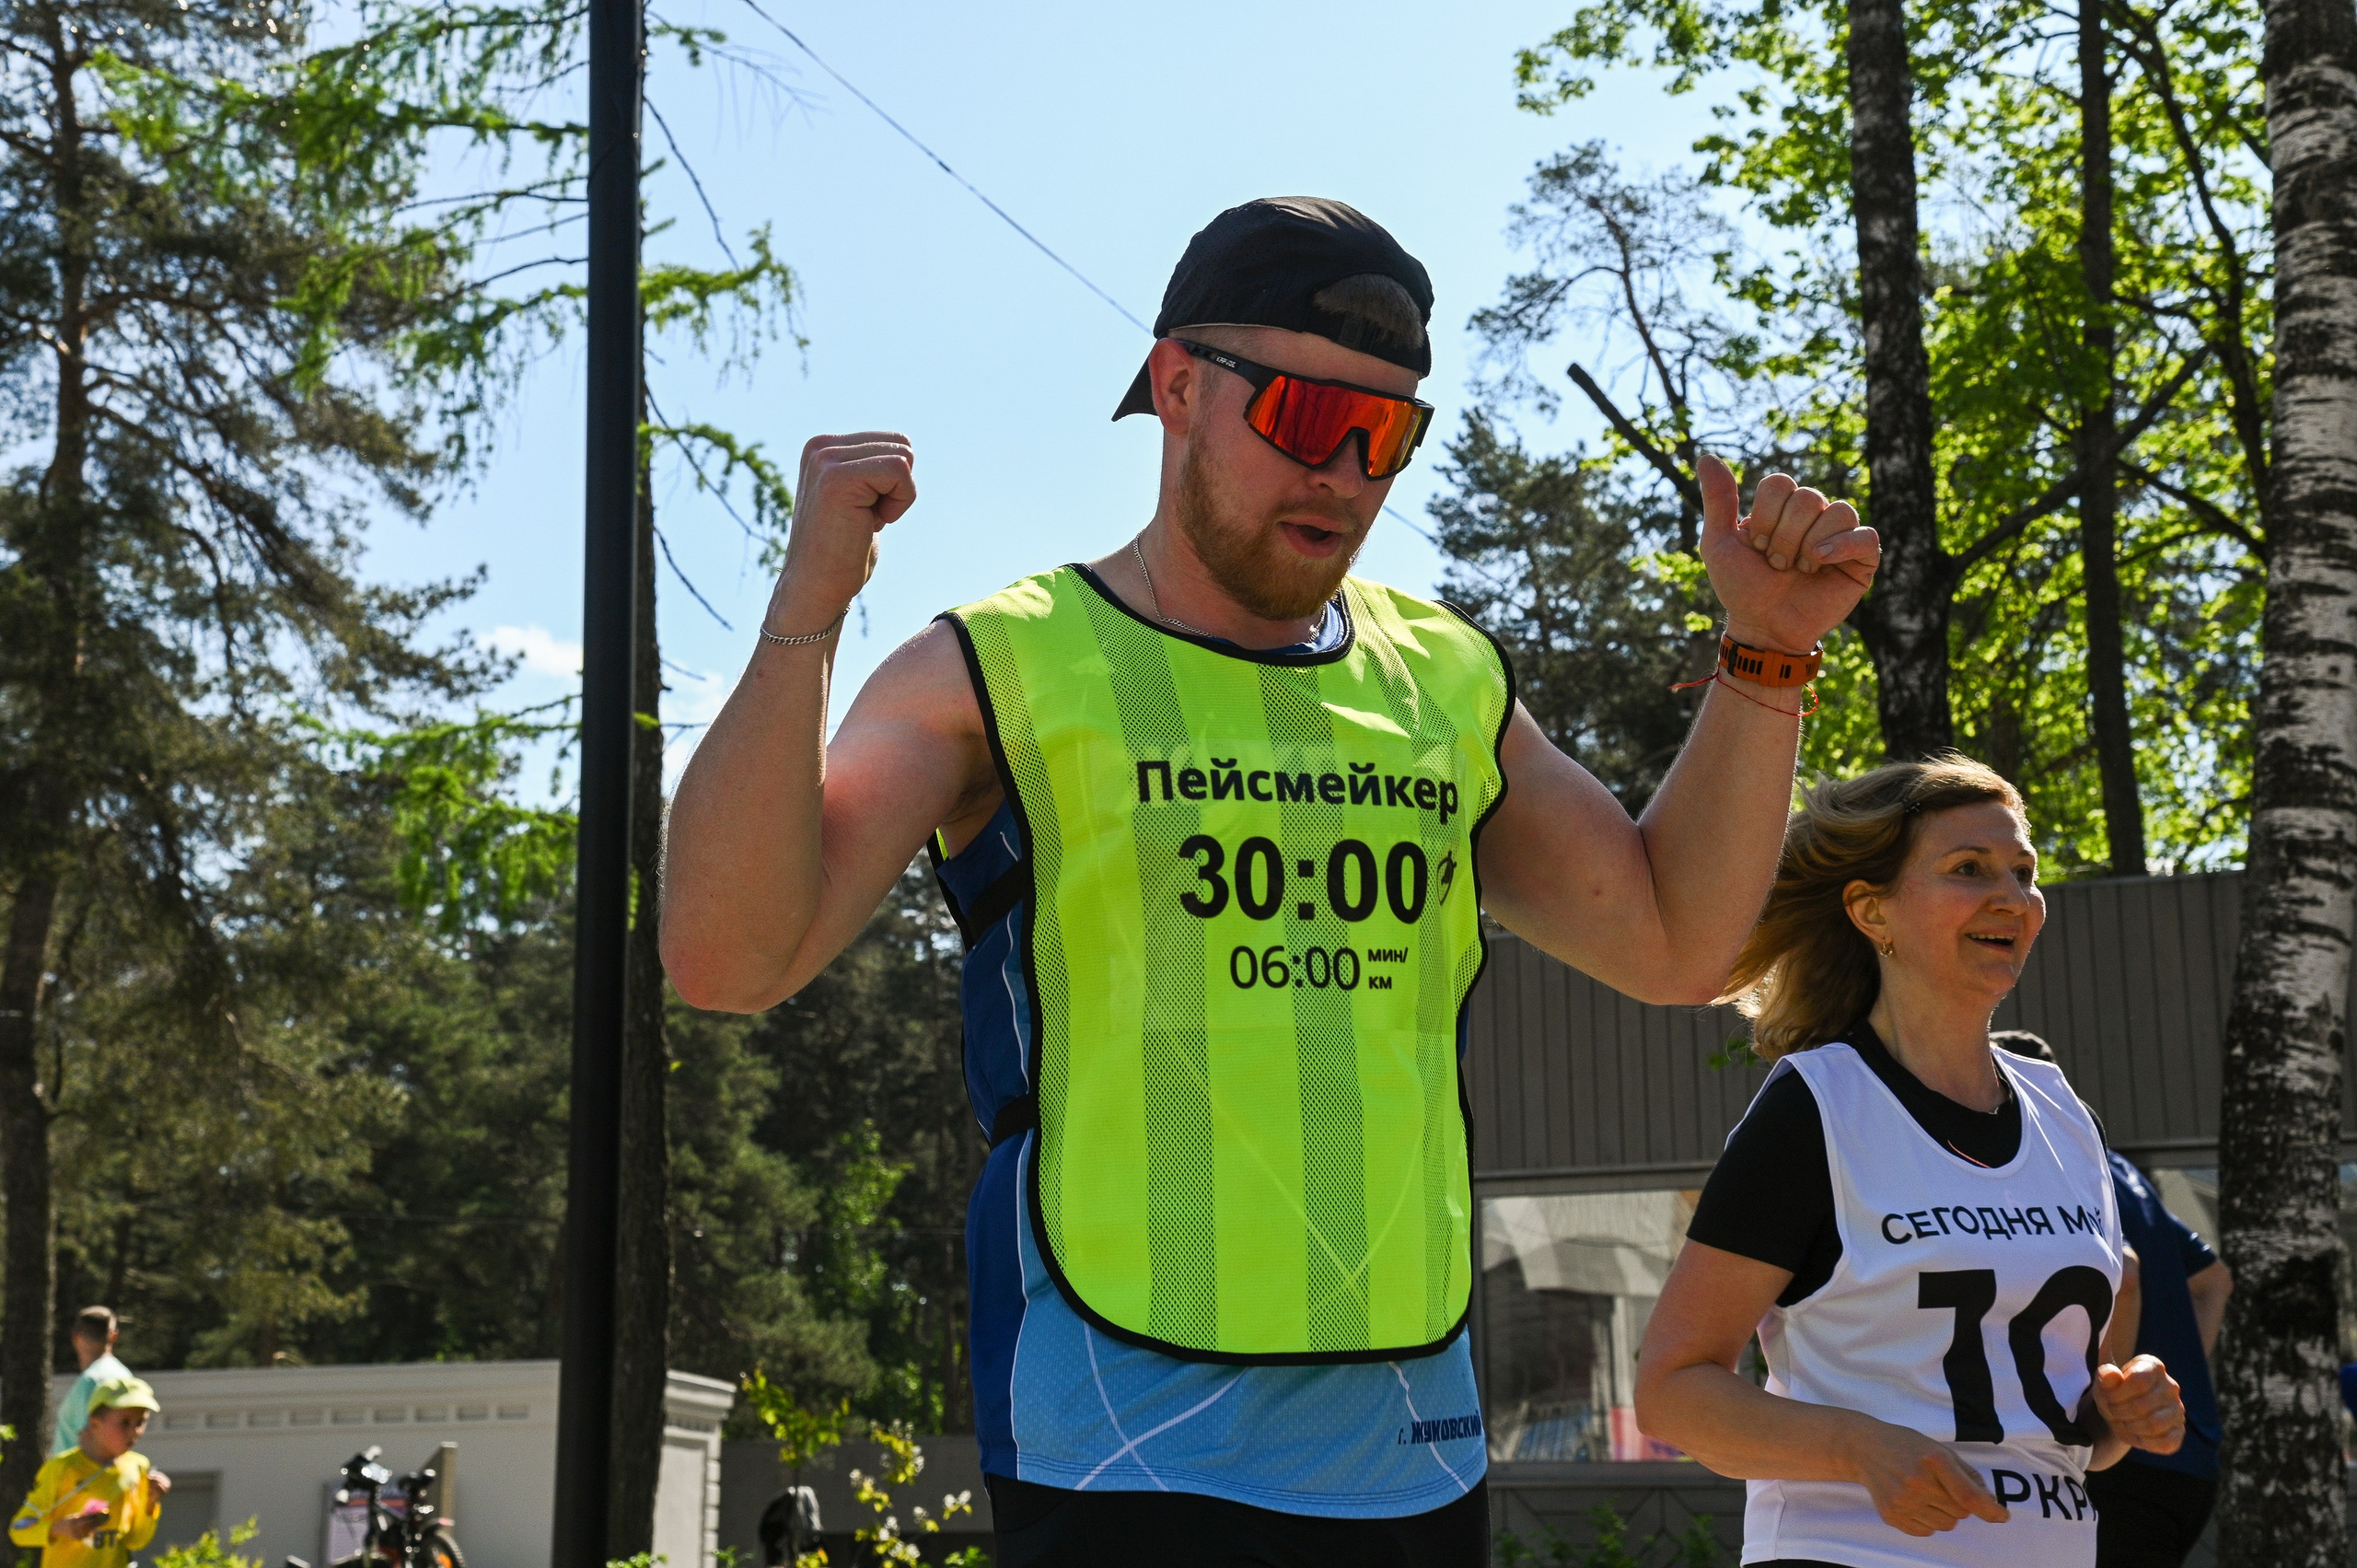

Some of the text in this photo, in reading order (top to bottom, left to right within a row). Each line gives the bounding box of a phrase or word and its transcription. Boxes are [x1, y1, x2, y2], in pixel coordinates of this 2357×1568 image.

[1136, 758, 1458, 824] Пейсмейкер
[1179, 834, 1428, 923] 30:00
[1230, 945, 1409, 991] 06:00 мин/
[1368, 976, 1393, 990] км
[1881, 1205, 2055, 1245] СЕГОДНЯ
[1917, 1265, 2114, 1448] 10
[1991, 1469, 2097, 1522] РКР
